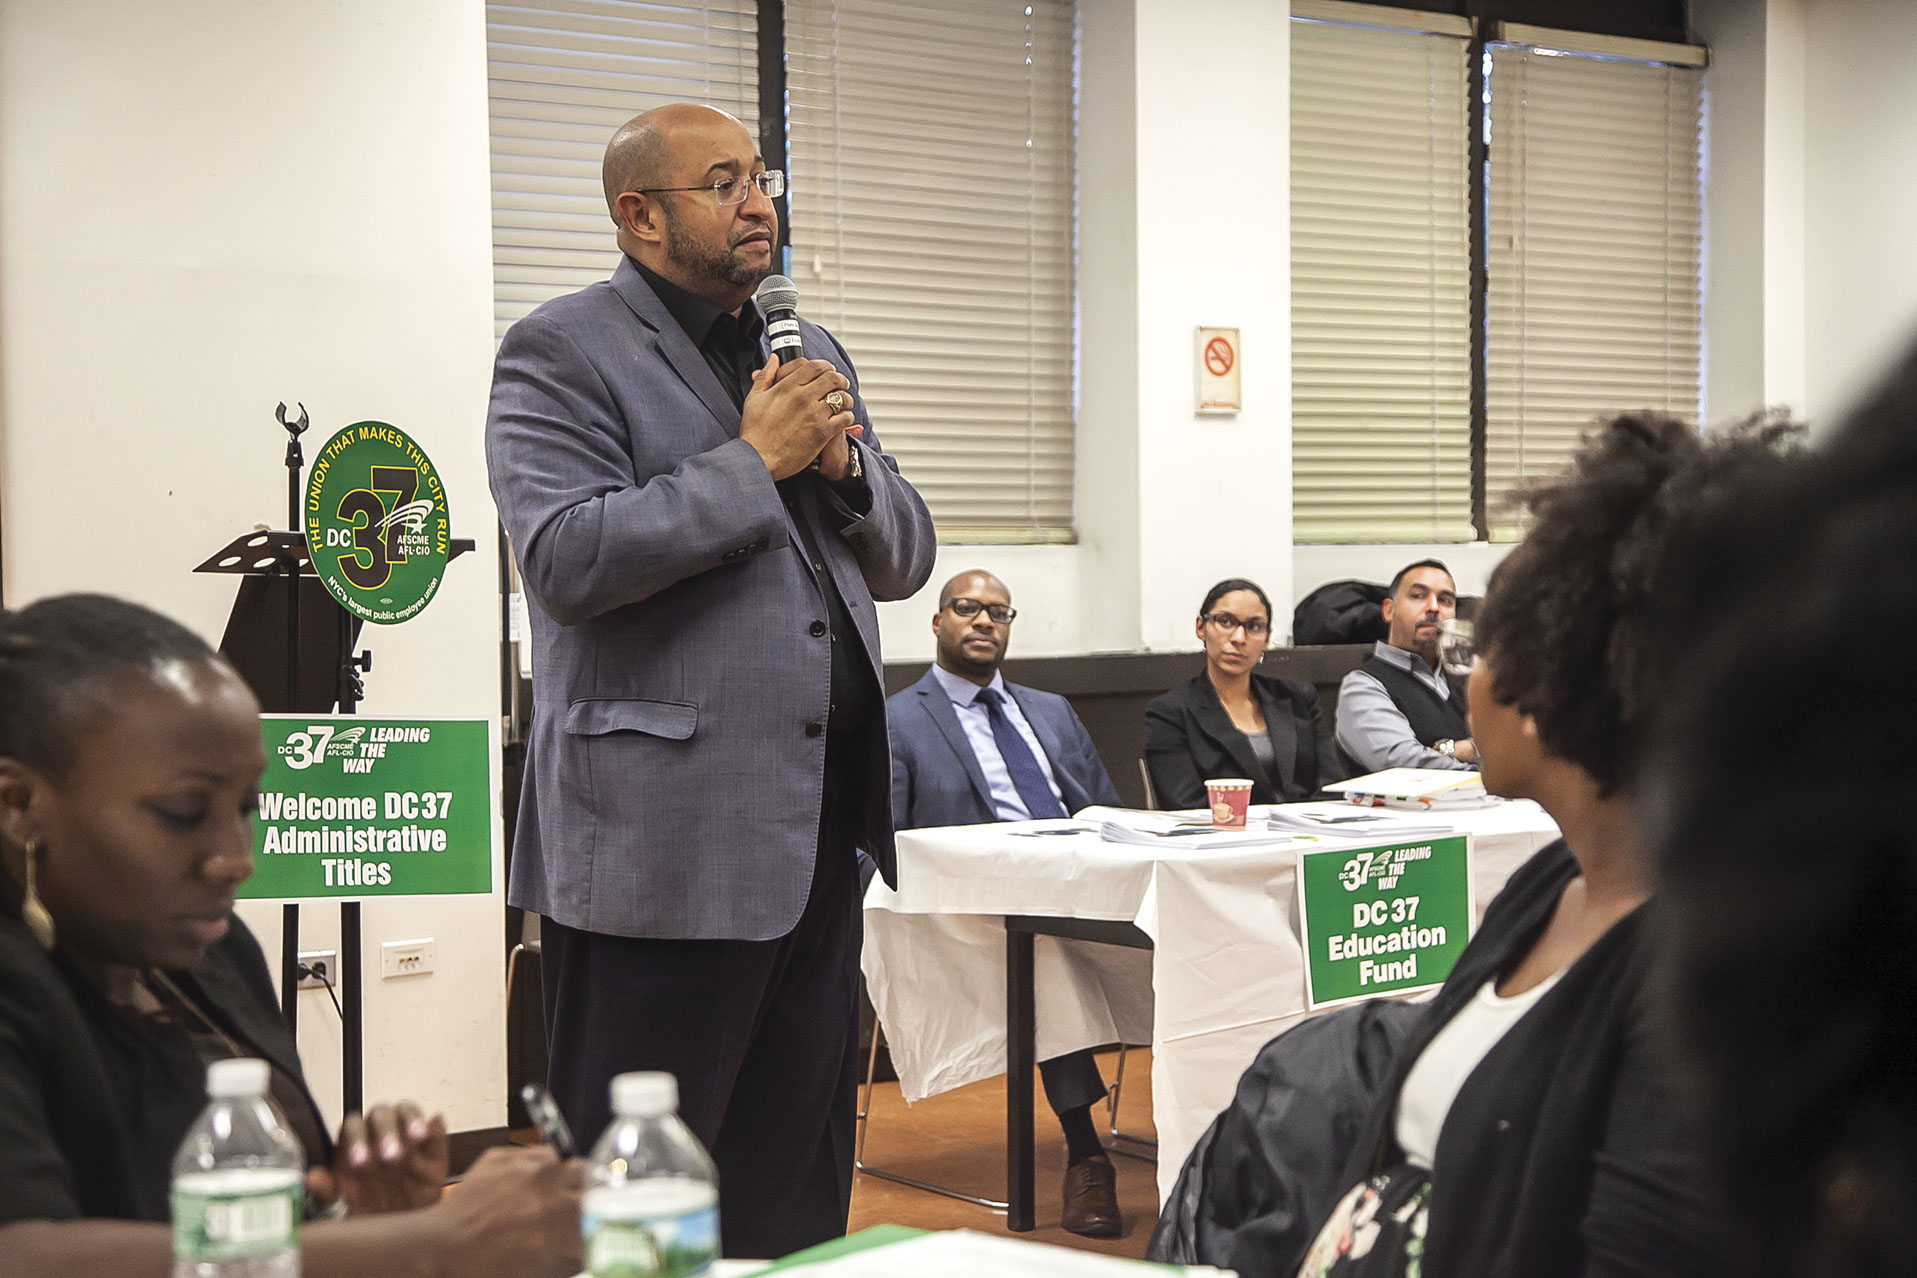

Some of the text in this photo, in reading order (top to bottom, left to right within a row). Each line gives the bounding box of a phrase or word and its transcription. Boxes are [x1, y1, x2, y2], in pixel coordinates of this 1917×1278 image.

[309, 426, 447, 555] THE UNION THAT MAKES THIS CITY RUN
[326, 465, 420, 590] DC 37
[397, 534, 430, 545] AFSCME
[328, 575, 439, 620] NYC's largest public employee union
[277, 725, 335, 770] DC 37
[369, 727, 431, 743] LEADING
[359, 742, 387, 758] THE
[342, 758, 376, 774] WAY
[259, 792, 377, 821] Welcome
[263, 824, 447, 854] Administrative
[1388, 861, 1406, 876] THE
[1394, 846, 1432, 862] LEADING
[321, 858, 392, 887] Titles
[1338, 851, 1375, 892] DC 37
[1377, 875, 1399, 891] WAY
[1353, 895, 1420, 929] DC 37
[1328, 924, 1446, 961] Education
[1359, 953, 1417, 986] Fund
